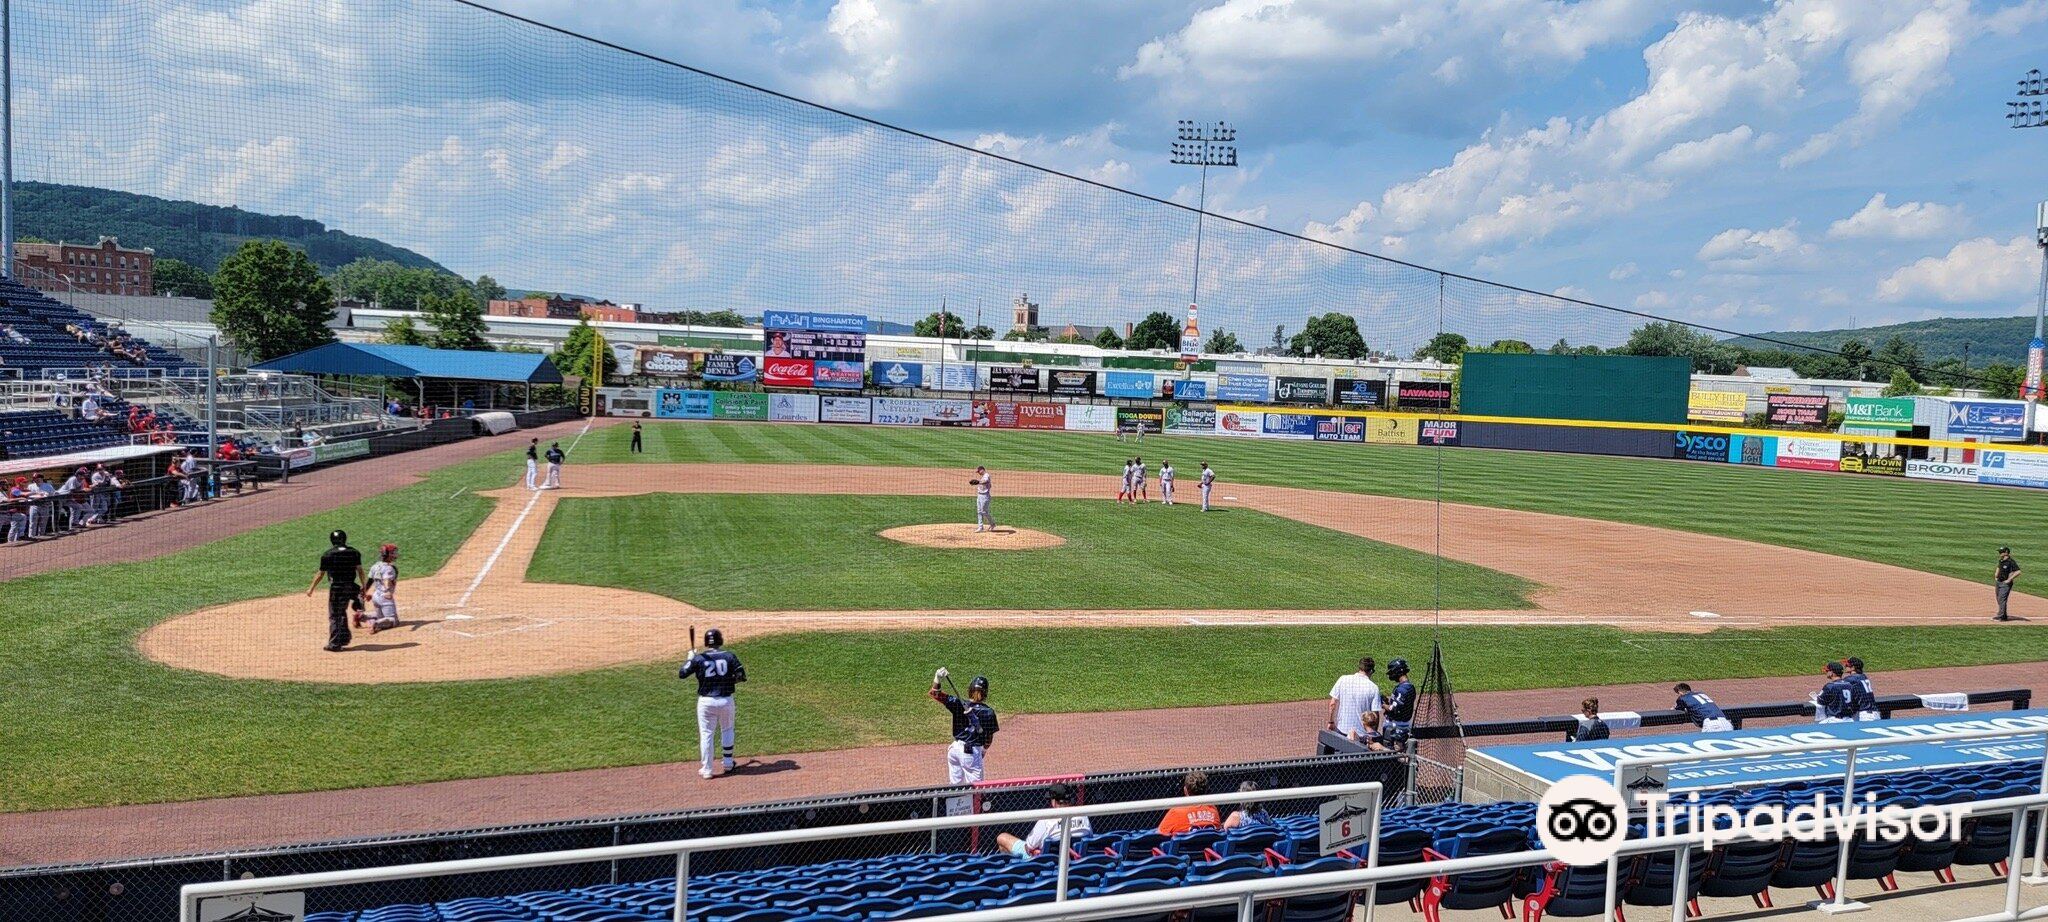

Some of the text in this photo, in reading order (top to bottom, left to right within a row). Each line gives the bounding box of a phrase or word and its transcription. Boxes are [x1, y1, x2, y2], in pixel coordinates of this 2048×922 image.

[812, 316, 863, 326] BINGHAMTON
[645, 360, 688, 371] Chopper
[1107, 382, 1134, 390] Excellus
[1400, 389, 1450, 398] RAYMOND
[1691, 392, 1744, 402] BULLY HILL
[1020, 406, 1054, 417] nycm
[1182, 410, 1216, 418] Gallagher
[1846, 403, 1902, 416] M&T Bank
[1318, 417, 1361, 434] miller
[1424, 420, 1456, 428] MAJOR
[1377, 429, 1406, 438] Battisti
[1676, 432, 1726, 452] Sysco
[1868, 458, 1902, 467] UPTOWN
[1908, 464, 1978, 476] BROOME
[704, 659, 728, 678] 20
[1842, 689, 1852, 704] 9
[1533, 731, 1869, 771] VISIONS
[1740, 760, 1828, 772] CREDIT
[1830, 754, 1912, 766] UNION
[1342, 820, 1351, 838] 6
